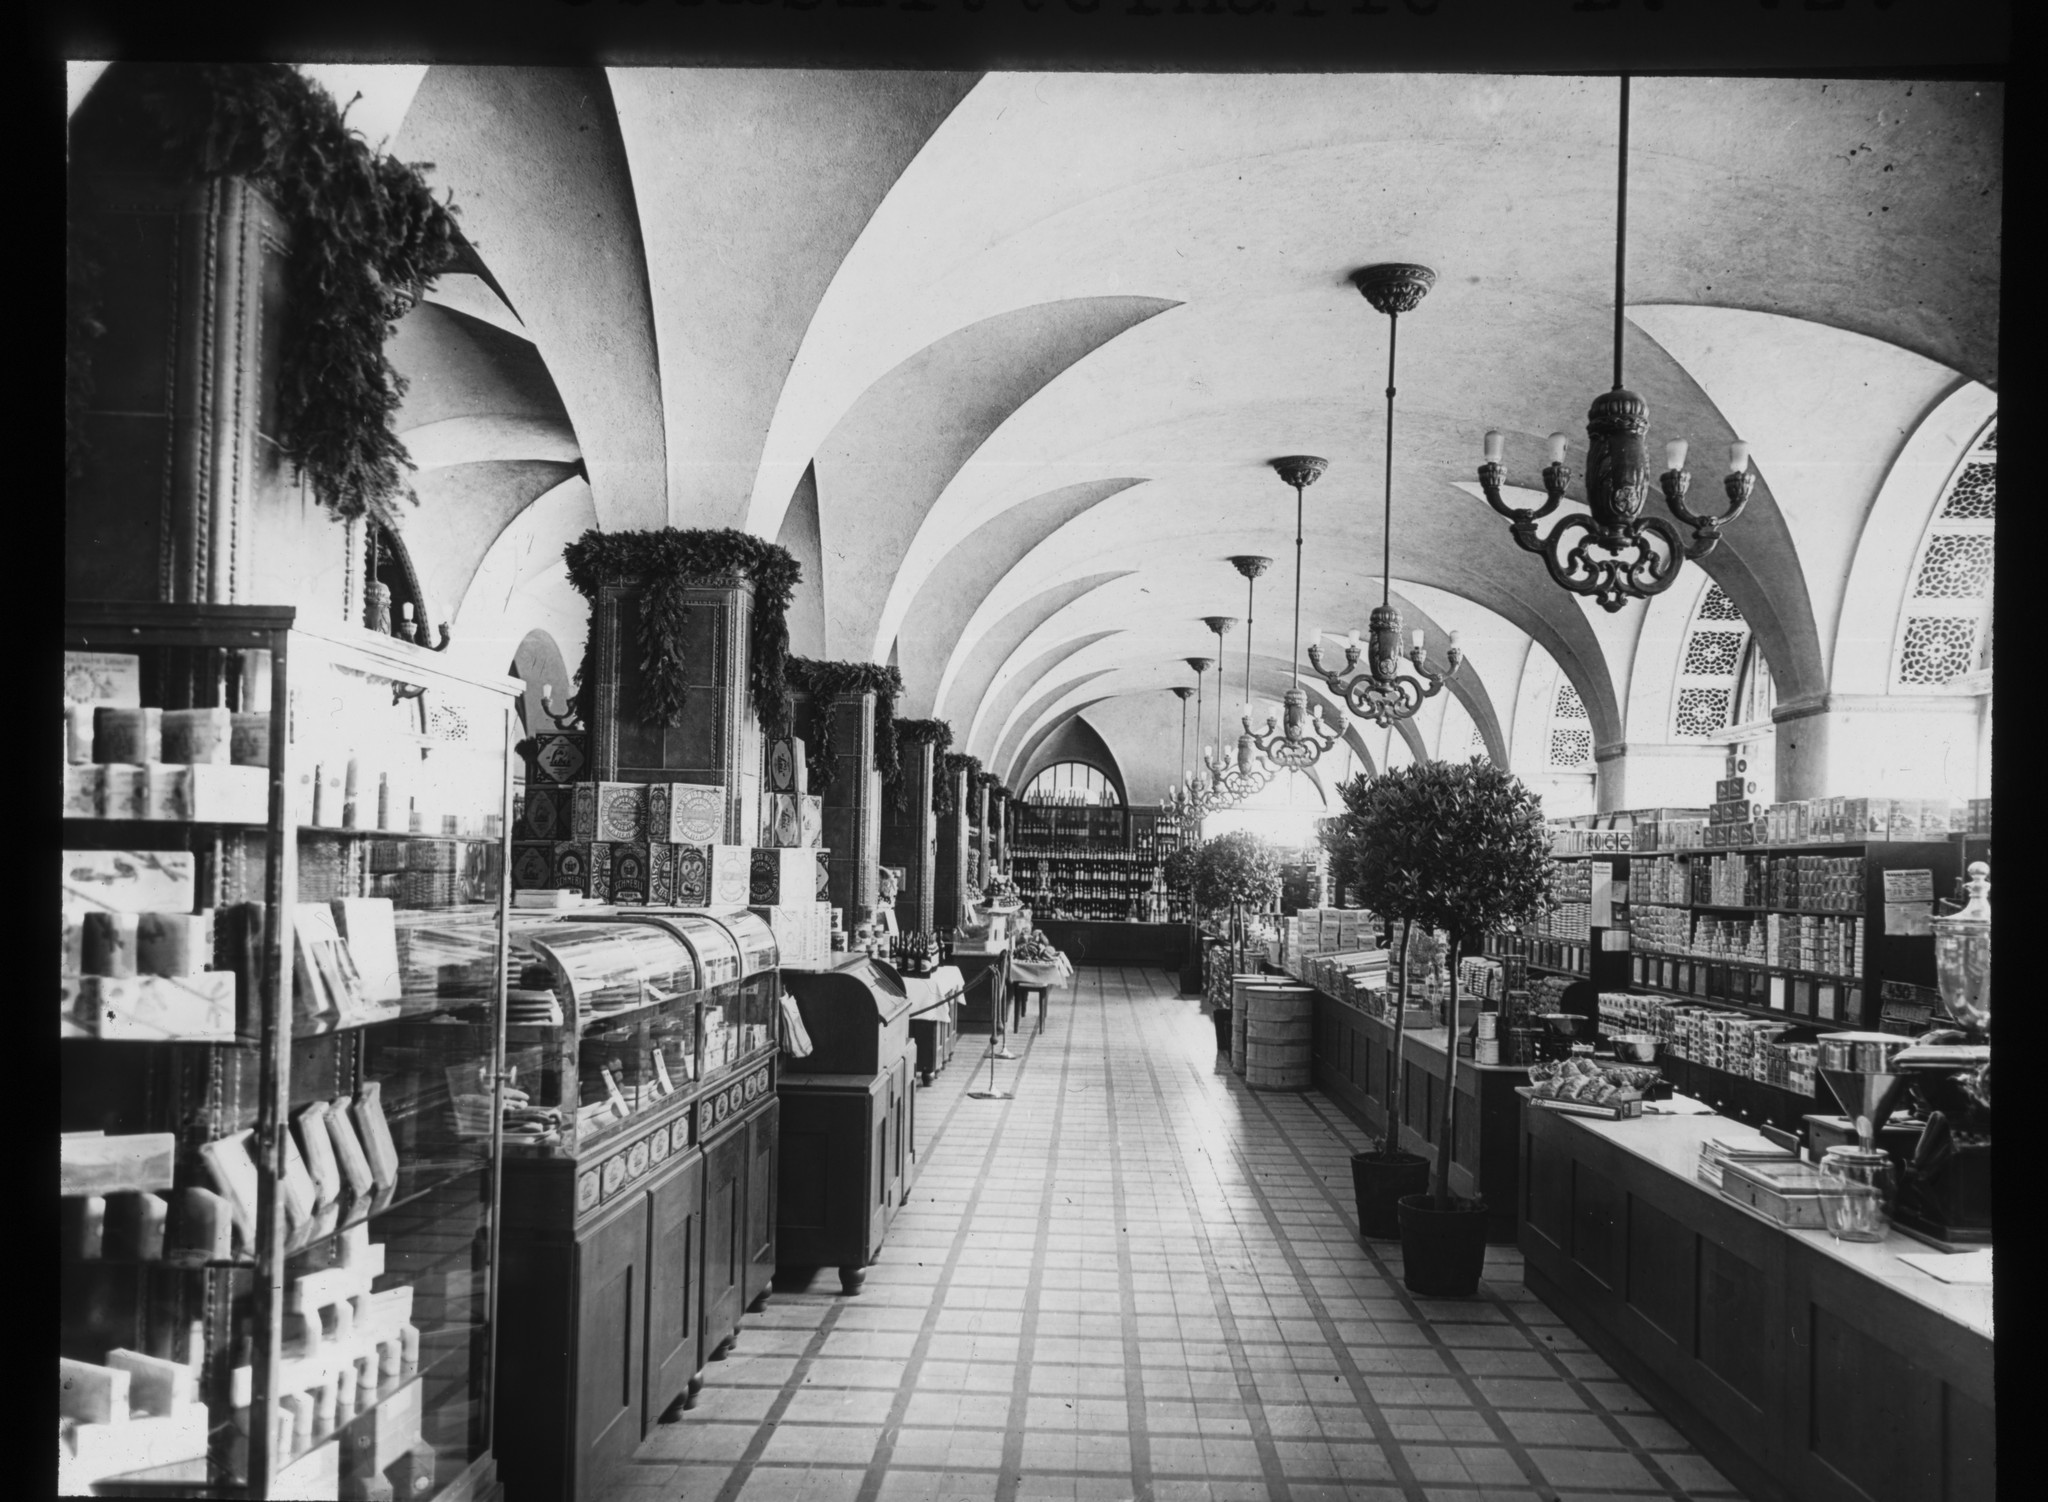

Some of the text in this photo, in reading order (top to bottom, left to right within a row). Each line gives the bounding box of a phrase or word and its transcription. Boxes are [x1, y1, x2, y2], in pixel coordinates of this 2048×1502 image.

[592, 849, 610, 884] BISCUITS
[651, 850, 670, 886] BISCUITS
[614, 879, 643, 892] SCHNEBLI
